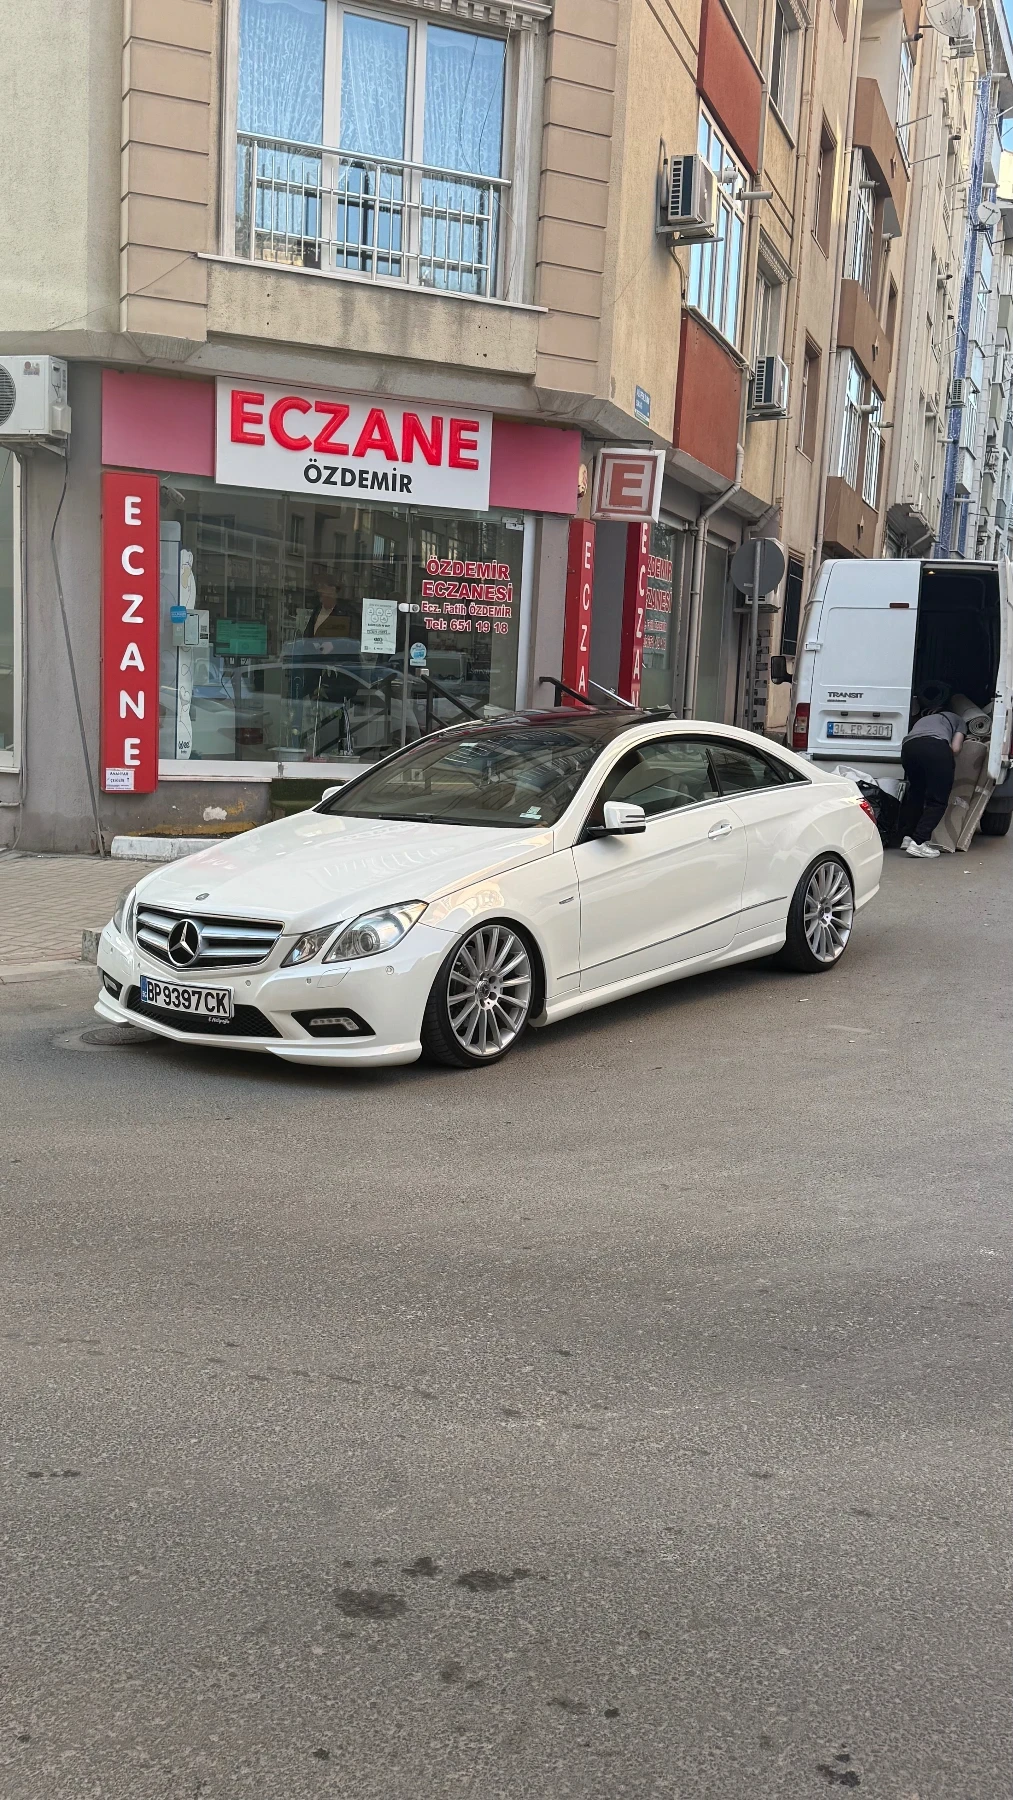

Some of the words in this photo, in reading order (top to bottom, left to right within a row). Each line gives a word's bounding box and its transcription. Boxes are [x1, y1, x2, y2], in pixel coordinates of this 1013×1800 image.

[231, 389, 480, 471] ECZANE
[303, 458, 413, 493] ÖZDEMİR
[608, 463, 646, 508] E
[426, 555, 511, 580] ÖZDEMİR
[421, 579, 513, 602] ECZANESİ
[421, 601, 442, 614] Ecz.
[443, 603, 467, 616] Fatih
[468, 602, 512, 618] ÖZDEMİR
[578, 541, 592, 693] ECZA
[632, 522, 648, 708] ECZAN
[119, 495, 145, 765] ECZANE
[424, 617, 448, 631] Tel:
[450, 618, 472, 632] 651
[476, 621, 491, 633] 19
[494, 622, 509, 634] 18
[827, 691, 864, 699] TRANSIT
[834, 723, 845, 735] 34
[866, 725, 892, 738] 2301
